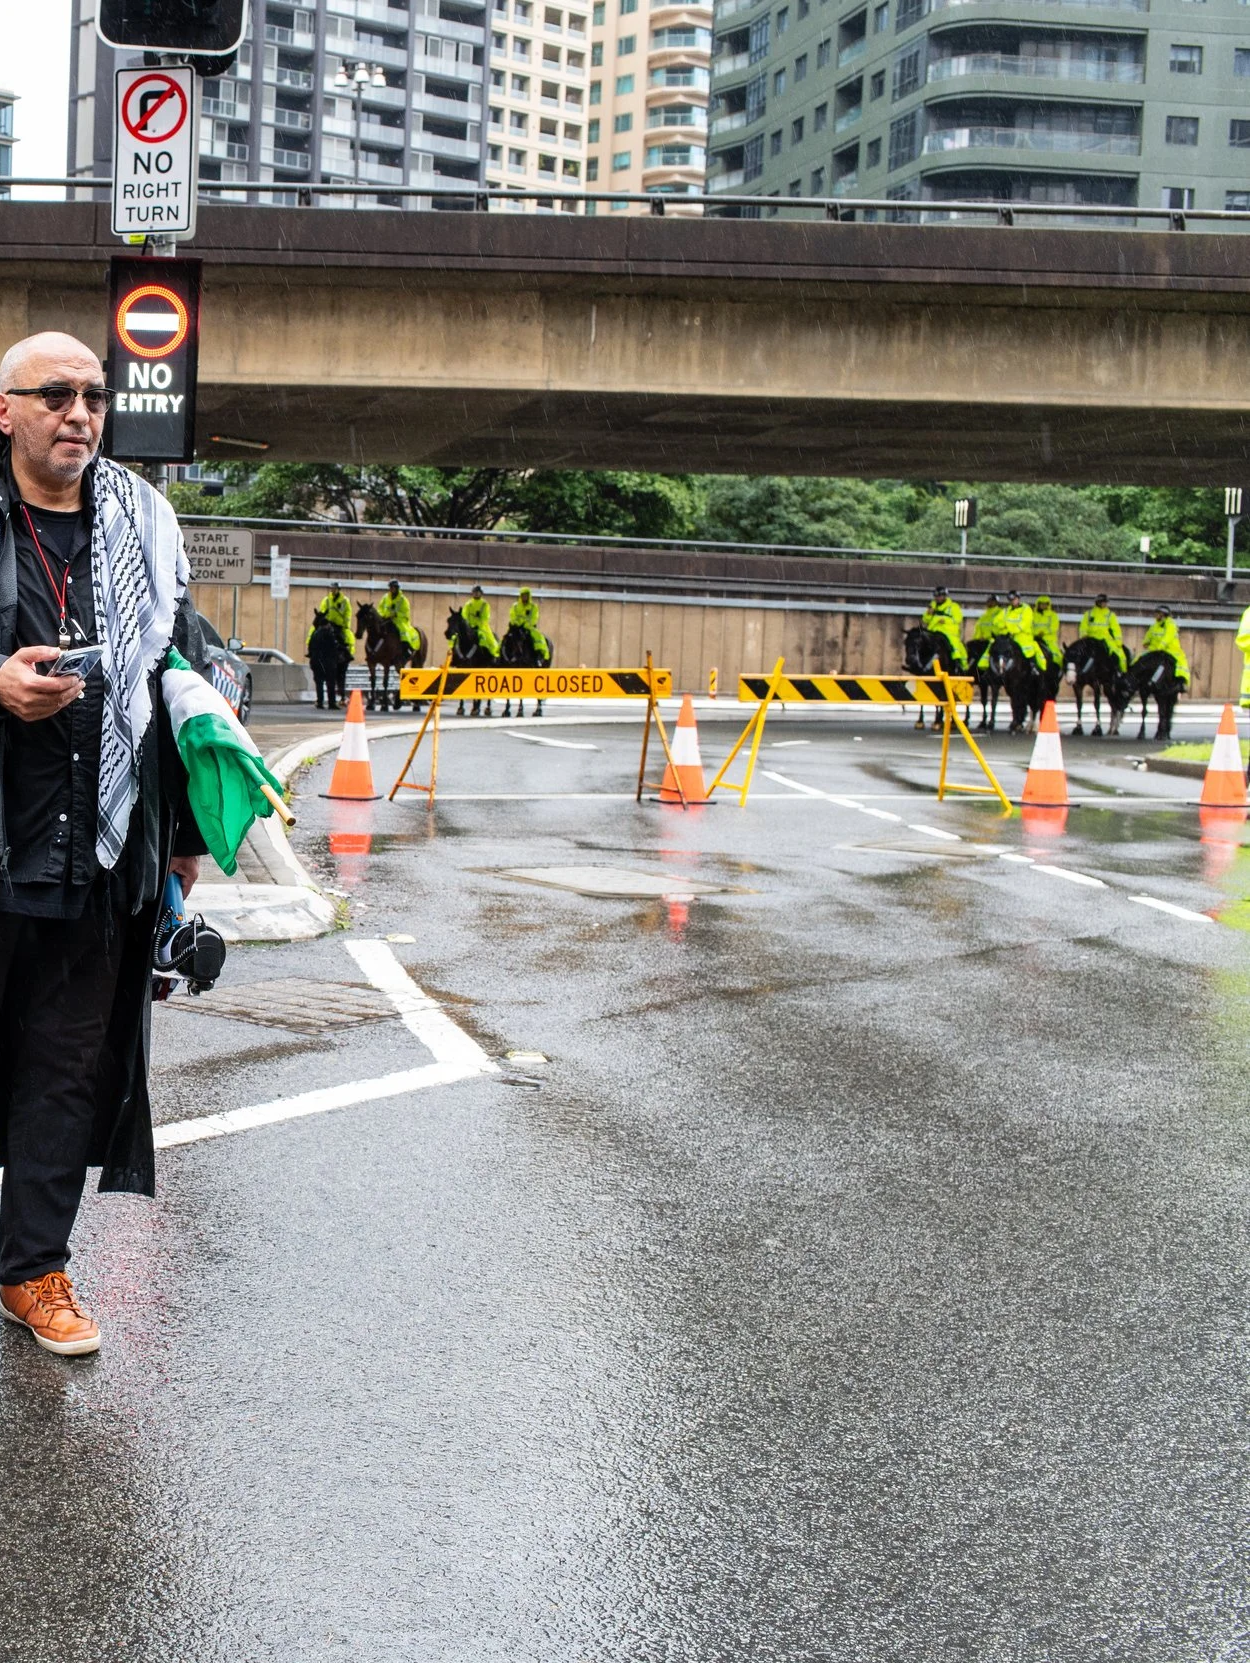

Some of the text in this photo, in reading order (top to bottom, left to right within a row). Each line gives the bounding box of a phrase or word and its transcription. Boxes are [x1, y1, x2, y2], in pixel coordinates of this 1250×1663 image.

[133, 151, 173, 175] NO
[123, 182, 182, 199] RIGHT
[125, 205, 180, 223] TURN
[127, 362, 173, 390] NO
[116, 392, 184, 413] ENTRY
[193, 532, 229, 543] START
[216, 558, 246, 568] LIMIT
[195, 569, 225, 580] ZONE
[475, 675, 604, 693] ROAD CLOSED
